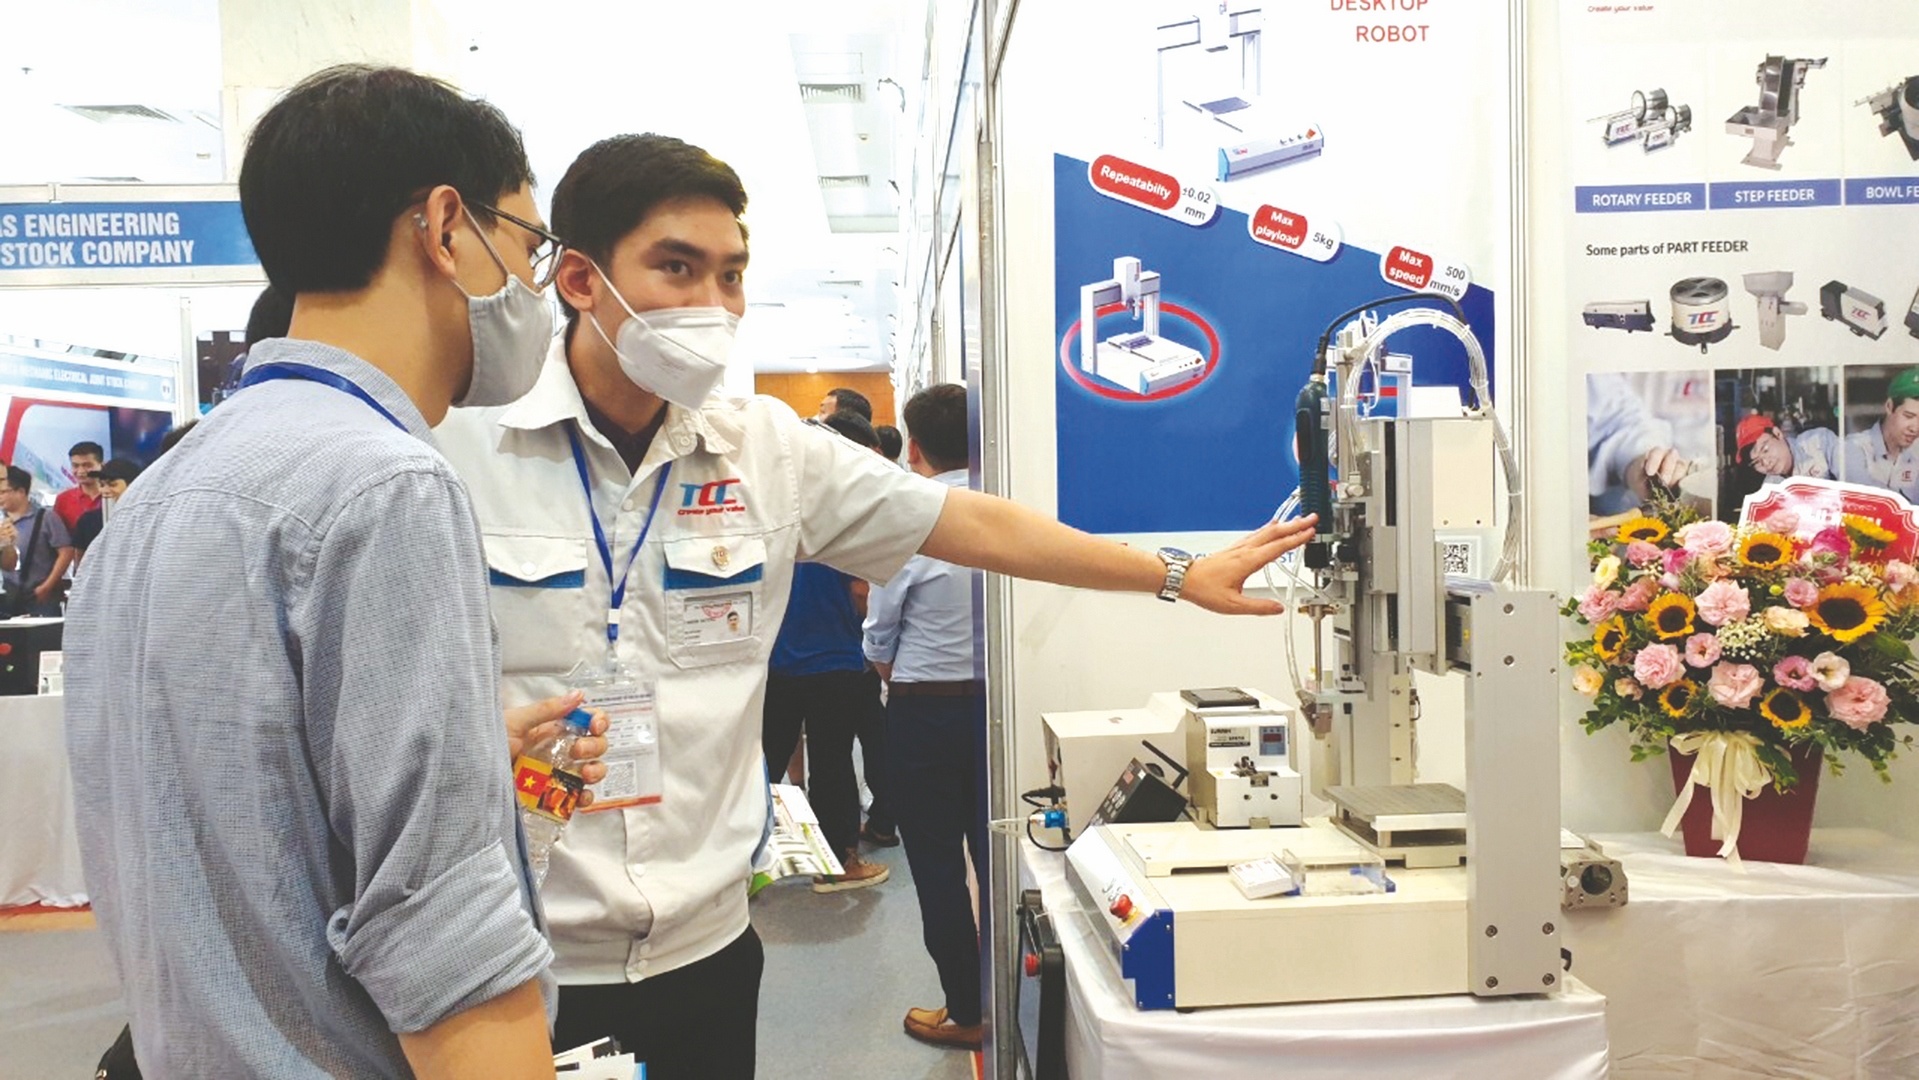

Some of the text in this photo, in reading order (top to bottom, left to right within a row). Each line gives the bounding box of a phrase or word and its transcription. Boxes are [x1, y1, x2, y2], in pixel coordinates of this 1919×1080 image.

[1356, 25, 1430, 42] ROBOT
[1101, 165, 1171, 200] Repeatabilty
[1592, 192, 1692, 206] ROTARY FEEDER
[1735, 188, 1815, 203] STEP FEEDER
[1866, 186, 1904, 199] BOWL
[1184, 206, 1206, 220] mm
[1270, 211, 1295, 227] Max
[0, 212, 180, 238] S ENGINEERING
[1255, 225, 1300, 246] playload
[1313, 232, 1334, 250] 5kg
[0, 240, 195, 267] STOCK COMPANY
[1586, 240, 1749, 258] Some parts of PART FEEDER
[1399, 250, 1424, 268] Max
[1389, 267, 1425, 286] speed
[1445, 265, 1466, 280] 500
[1429, 280, 1461, 297] mm/s
